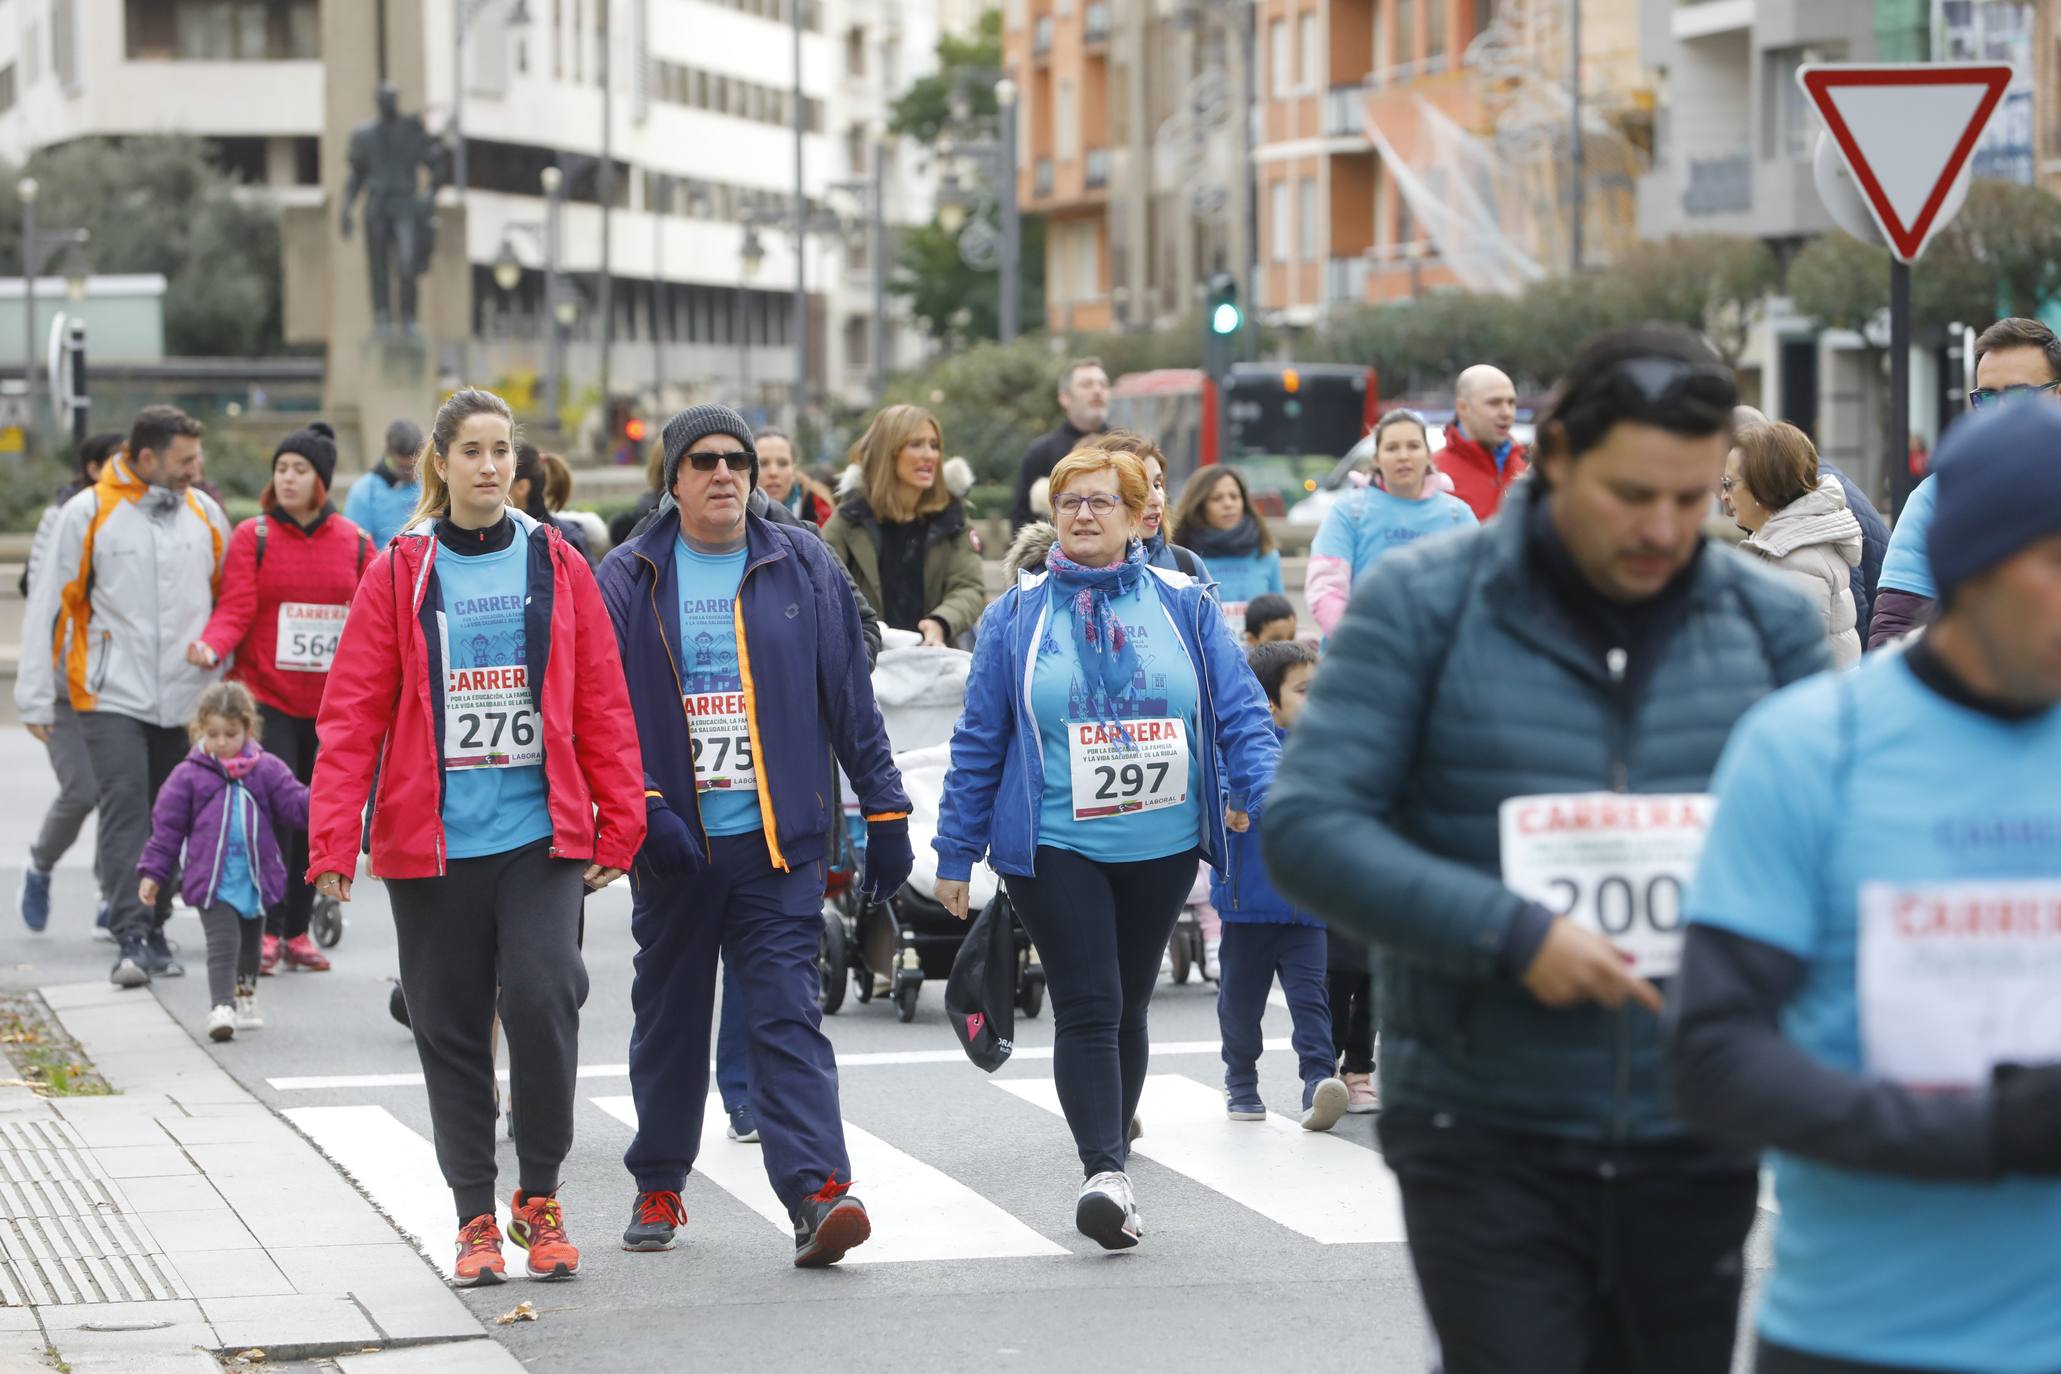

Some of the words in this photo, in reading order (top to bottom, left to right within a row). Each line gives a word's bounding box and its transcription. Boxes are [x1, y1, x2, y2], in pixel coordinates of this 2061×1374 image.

[454, 595, 522, 616] CARRER
[291, 633, 339, 657] 564
[475, 700, 506, 708] SALUDABLE
[458, 710, 535, 749] 276
[698, 725, 731, 733] SALUDABLE
[690, 736, 754, 773] 275
[1111, 752, 1142, 760] SALUDABLE
[1161, 749, 1178, 757] RIOJA
[1094, 761, 1169, 800] 297
[1145, 796, 1176, 806] LABORAL
[1547, 874, 1682, 935] 200
